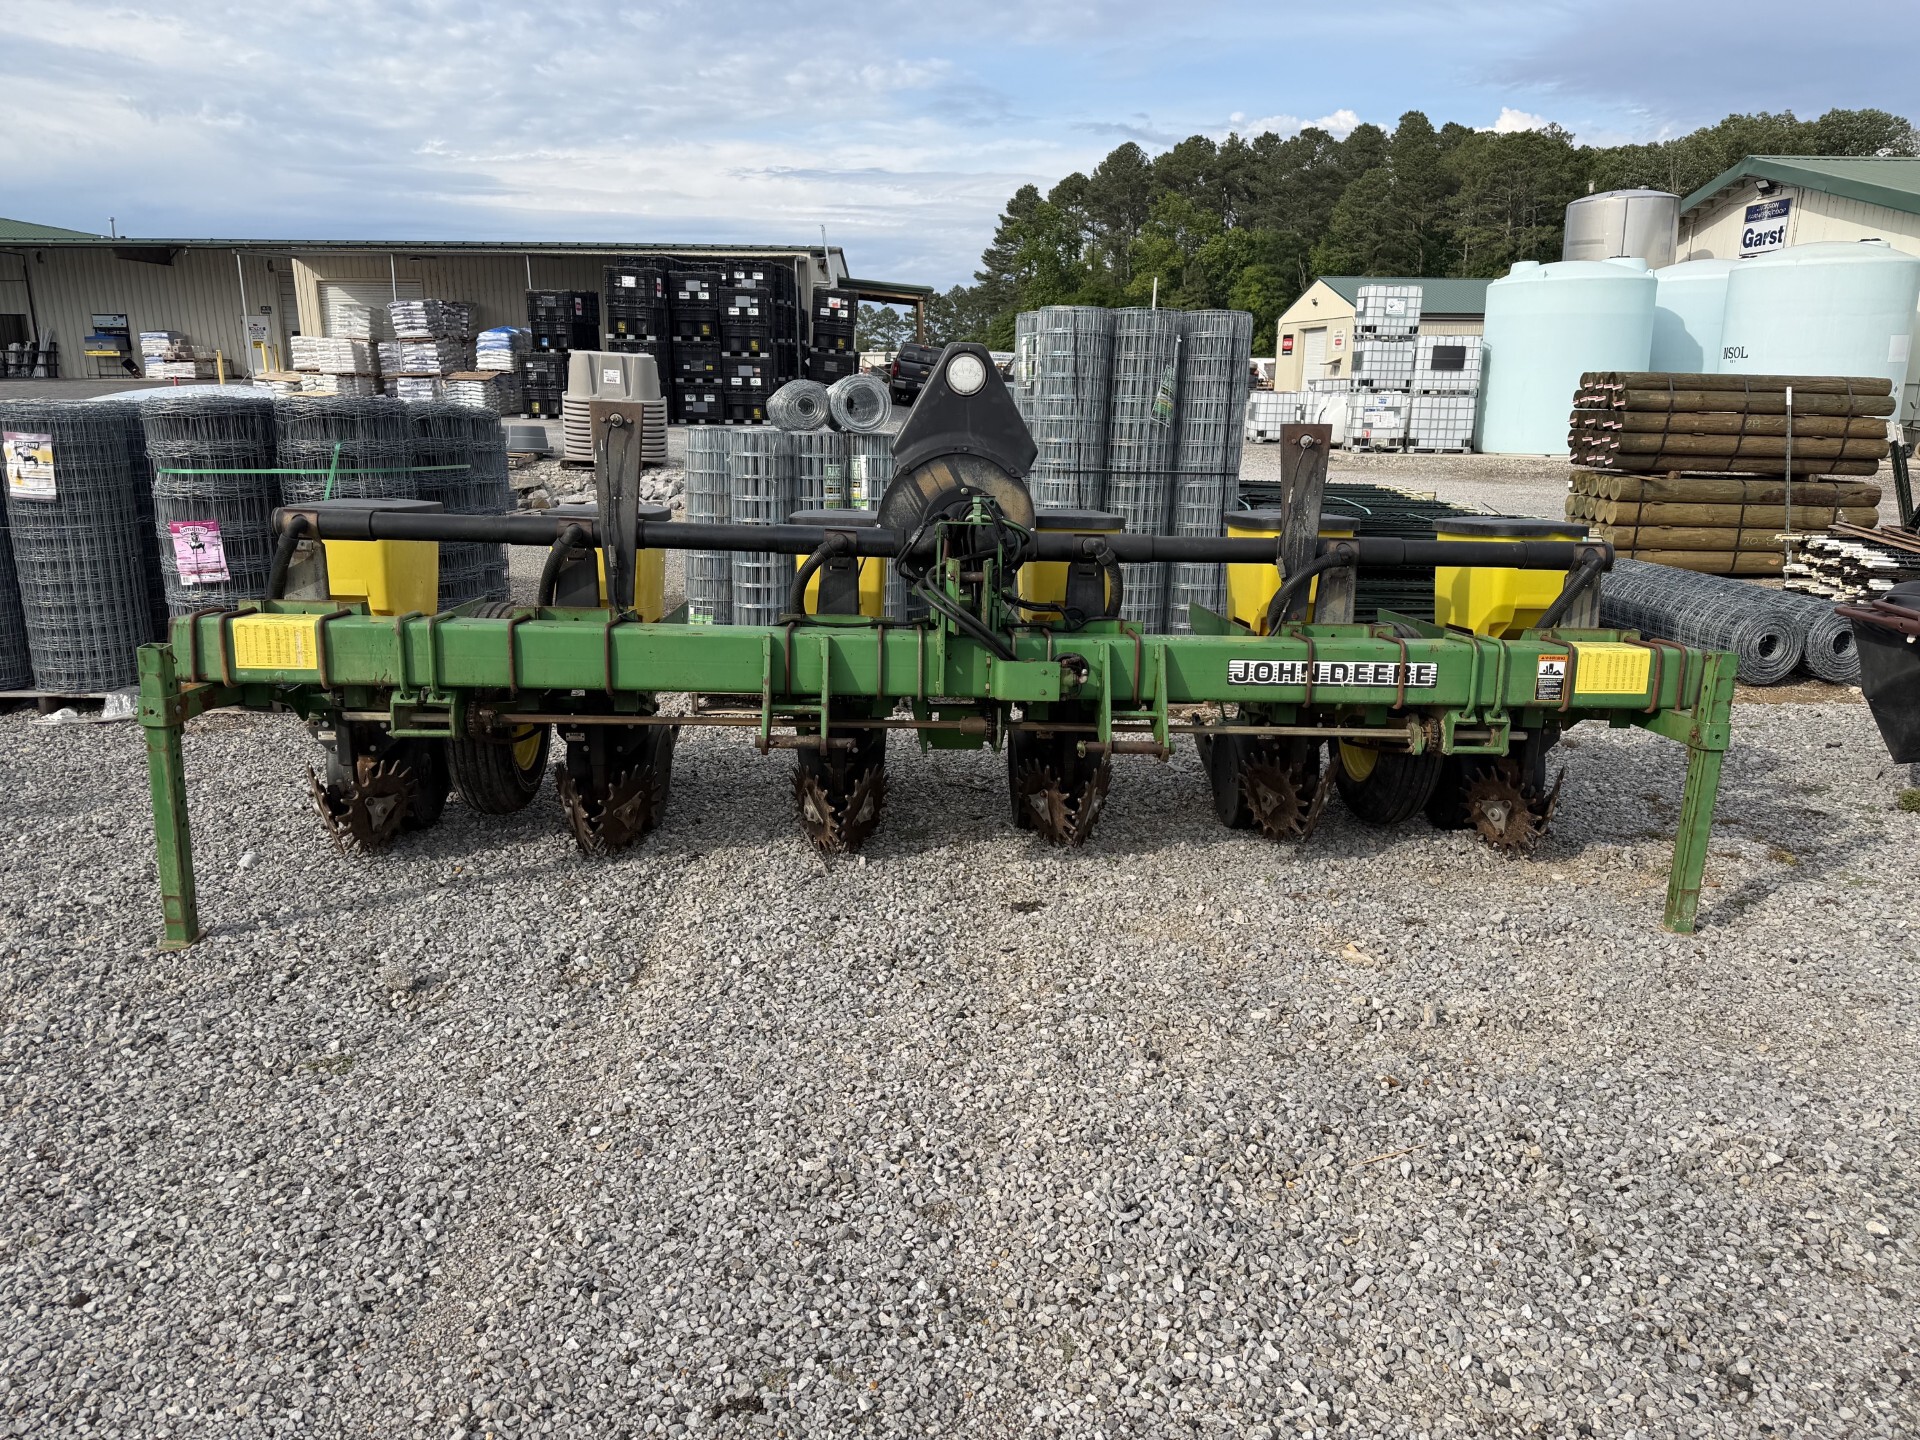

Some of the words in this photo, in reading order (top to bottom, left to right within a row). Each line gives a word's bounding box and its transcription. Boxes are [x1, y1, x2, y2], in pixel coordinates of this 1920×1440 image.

[1743, 225, 1785, 249] Garst
[1722, 346, 1749, 359] NSOL
[1233, 661, 1321, 682] JOHN
[1329, 663, 1432, 685] DEERE
